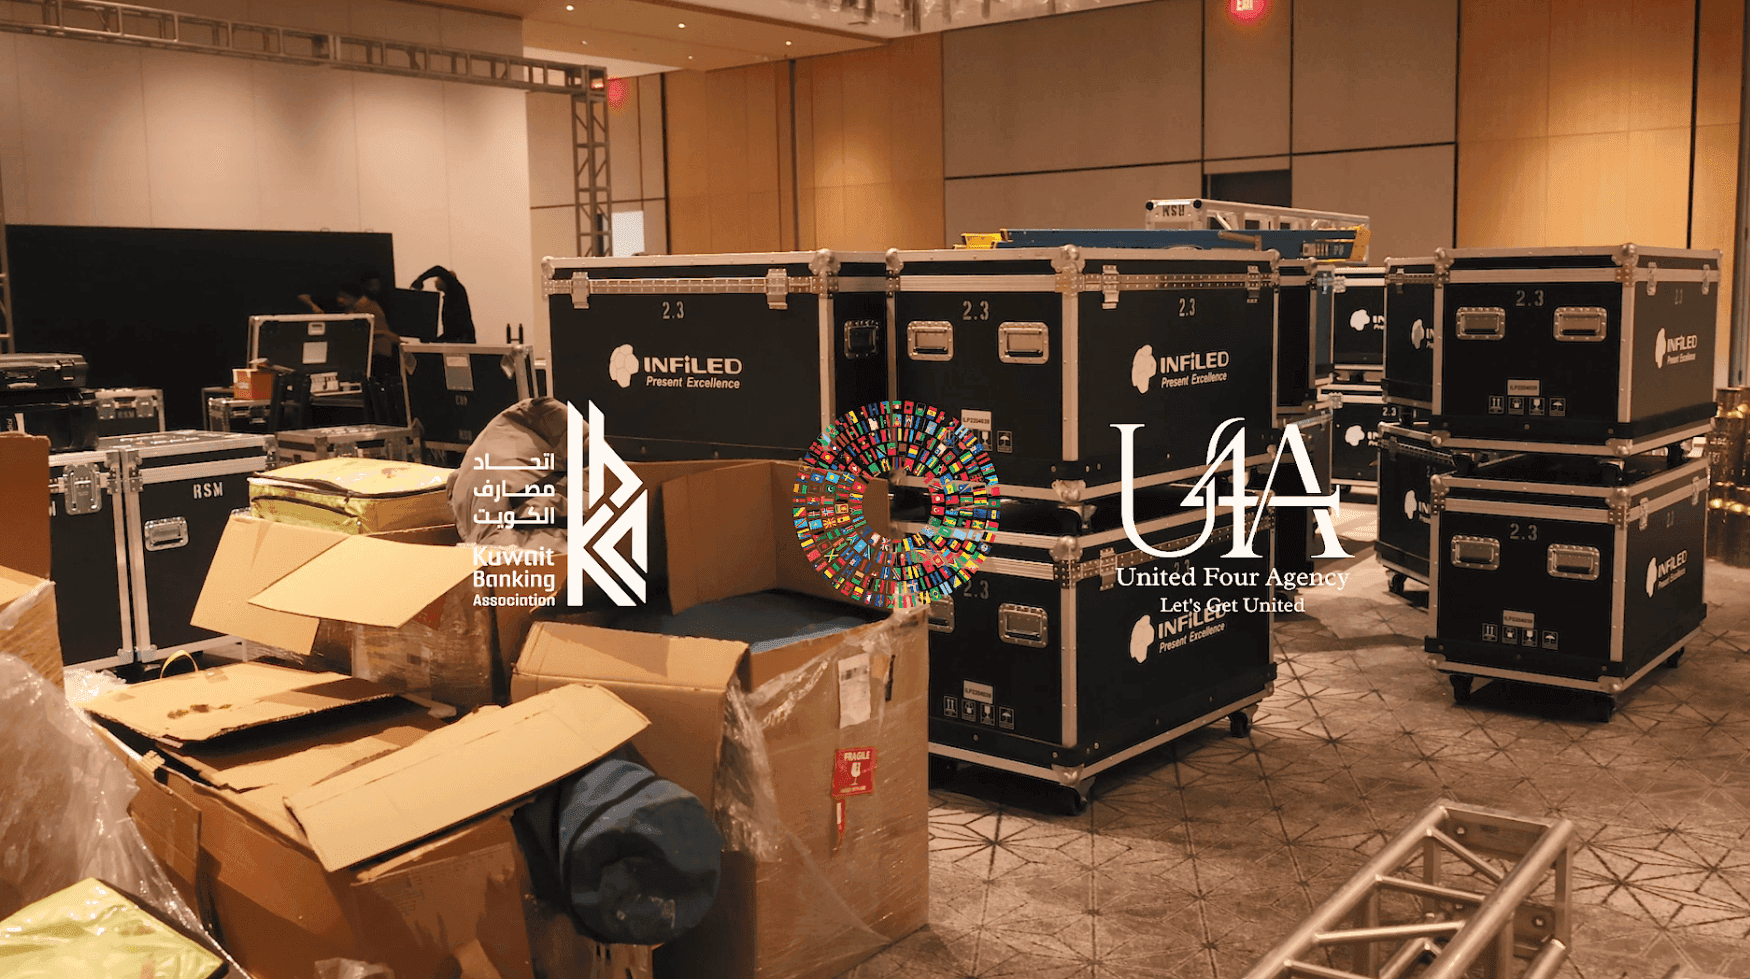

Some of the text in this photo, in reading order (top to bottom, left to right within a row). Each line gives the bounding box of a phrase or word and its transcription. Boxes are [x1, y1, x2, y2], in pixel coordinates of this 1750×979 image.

[1515, 289, 1544, 306] 2.3
[662, 301, 685, 319] 2.3
[962, 300, 990, 321] 2.3
[1179, 298, 1196, 317] 2.3
[646, 375, 741, 389] Present Excellence
[1161, 371, 1228, 389] Present Excellence
[1382, 407, 1397, 417] 2.3
[193, 481, 224, 499] RSM
[1509, 522, 1538, 542] 2.3
[963, 579, 989, 599] 2.3
[1159, 622, 1225, 653] Present Excellence
